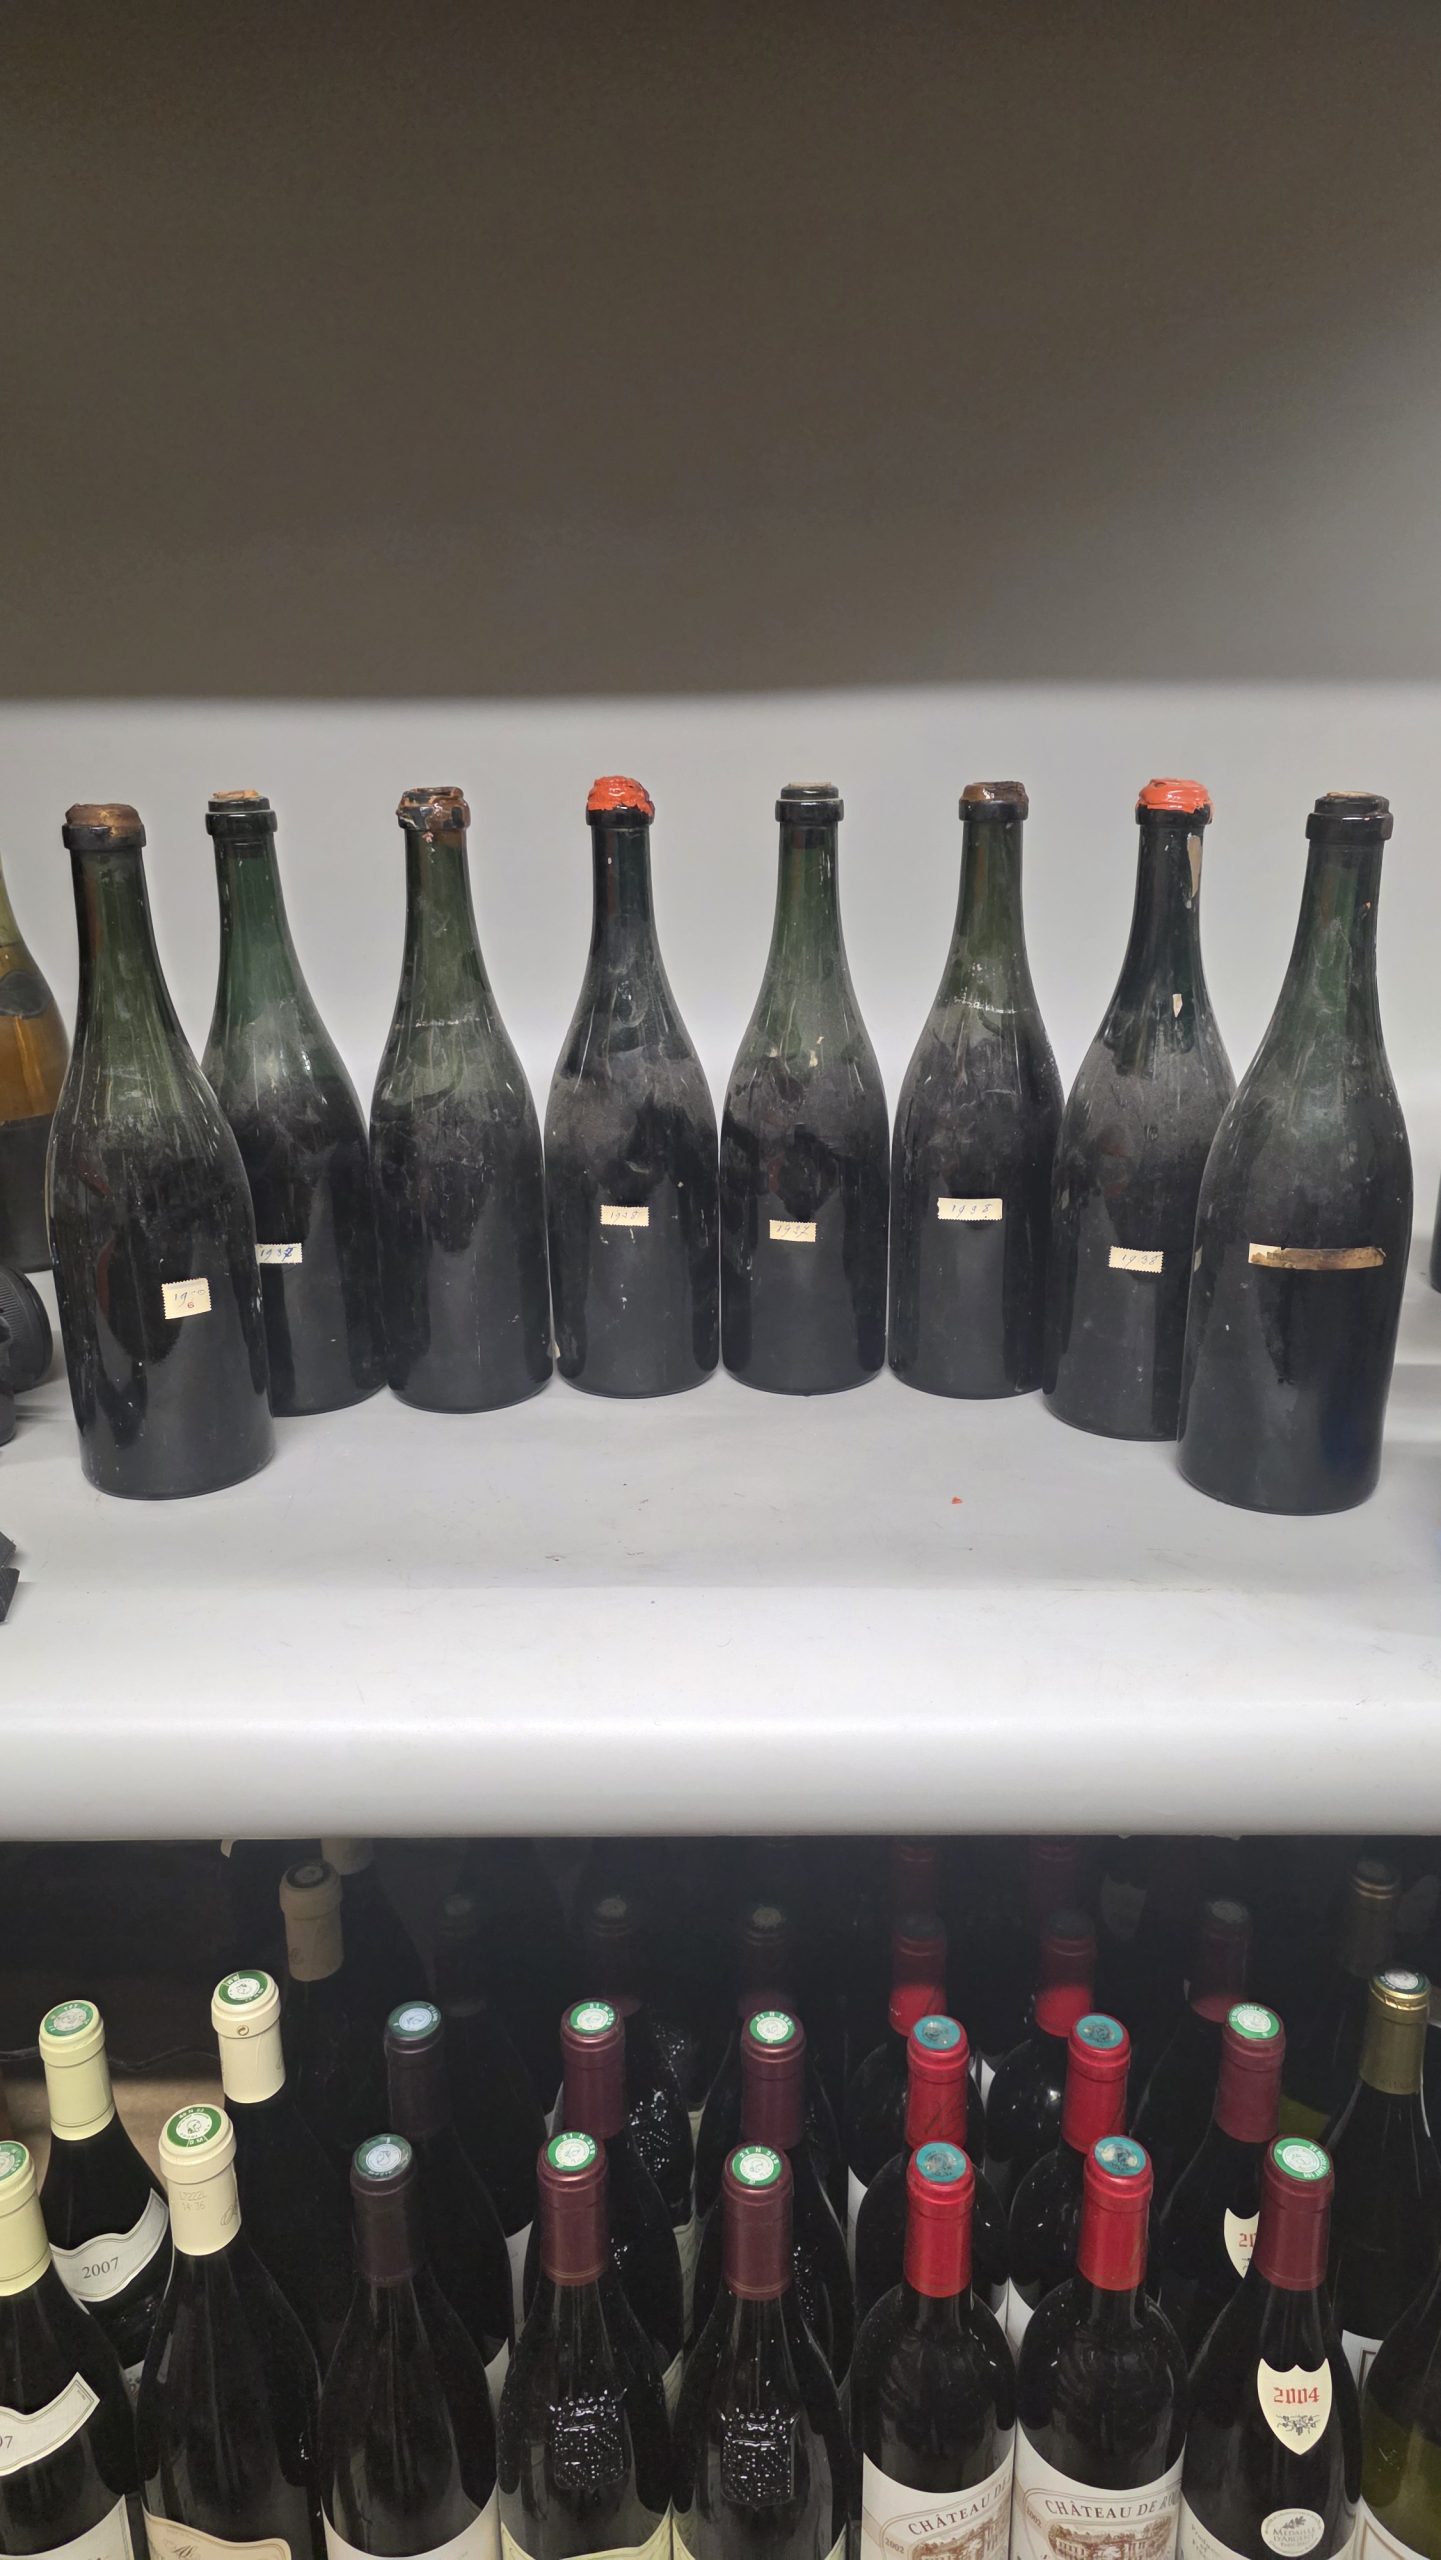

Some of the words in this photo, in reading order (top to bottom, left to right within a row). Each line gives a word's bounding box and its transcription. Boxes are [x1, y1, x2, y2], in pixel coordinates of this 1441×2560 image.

[81, 2256, 119, 2279] 2007
[1273, 2386, 1320, 2405] 2004
[908, 2493, 990, 2537] CHÂTEAU
[1045, 2500, 1132, 2519] CHÂTEAU
[1136, 2501, 1158, 2516] DE
[885, 2537, 905, 2554] 2002
